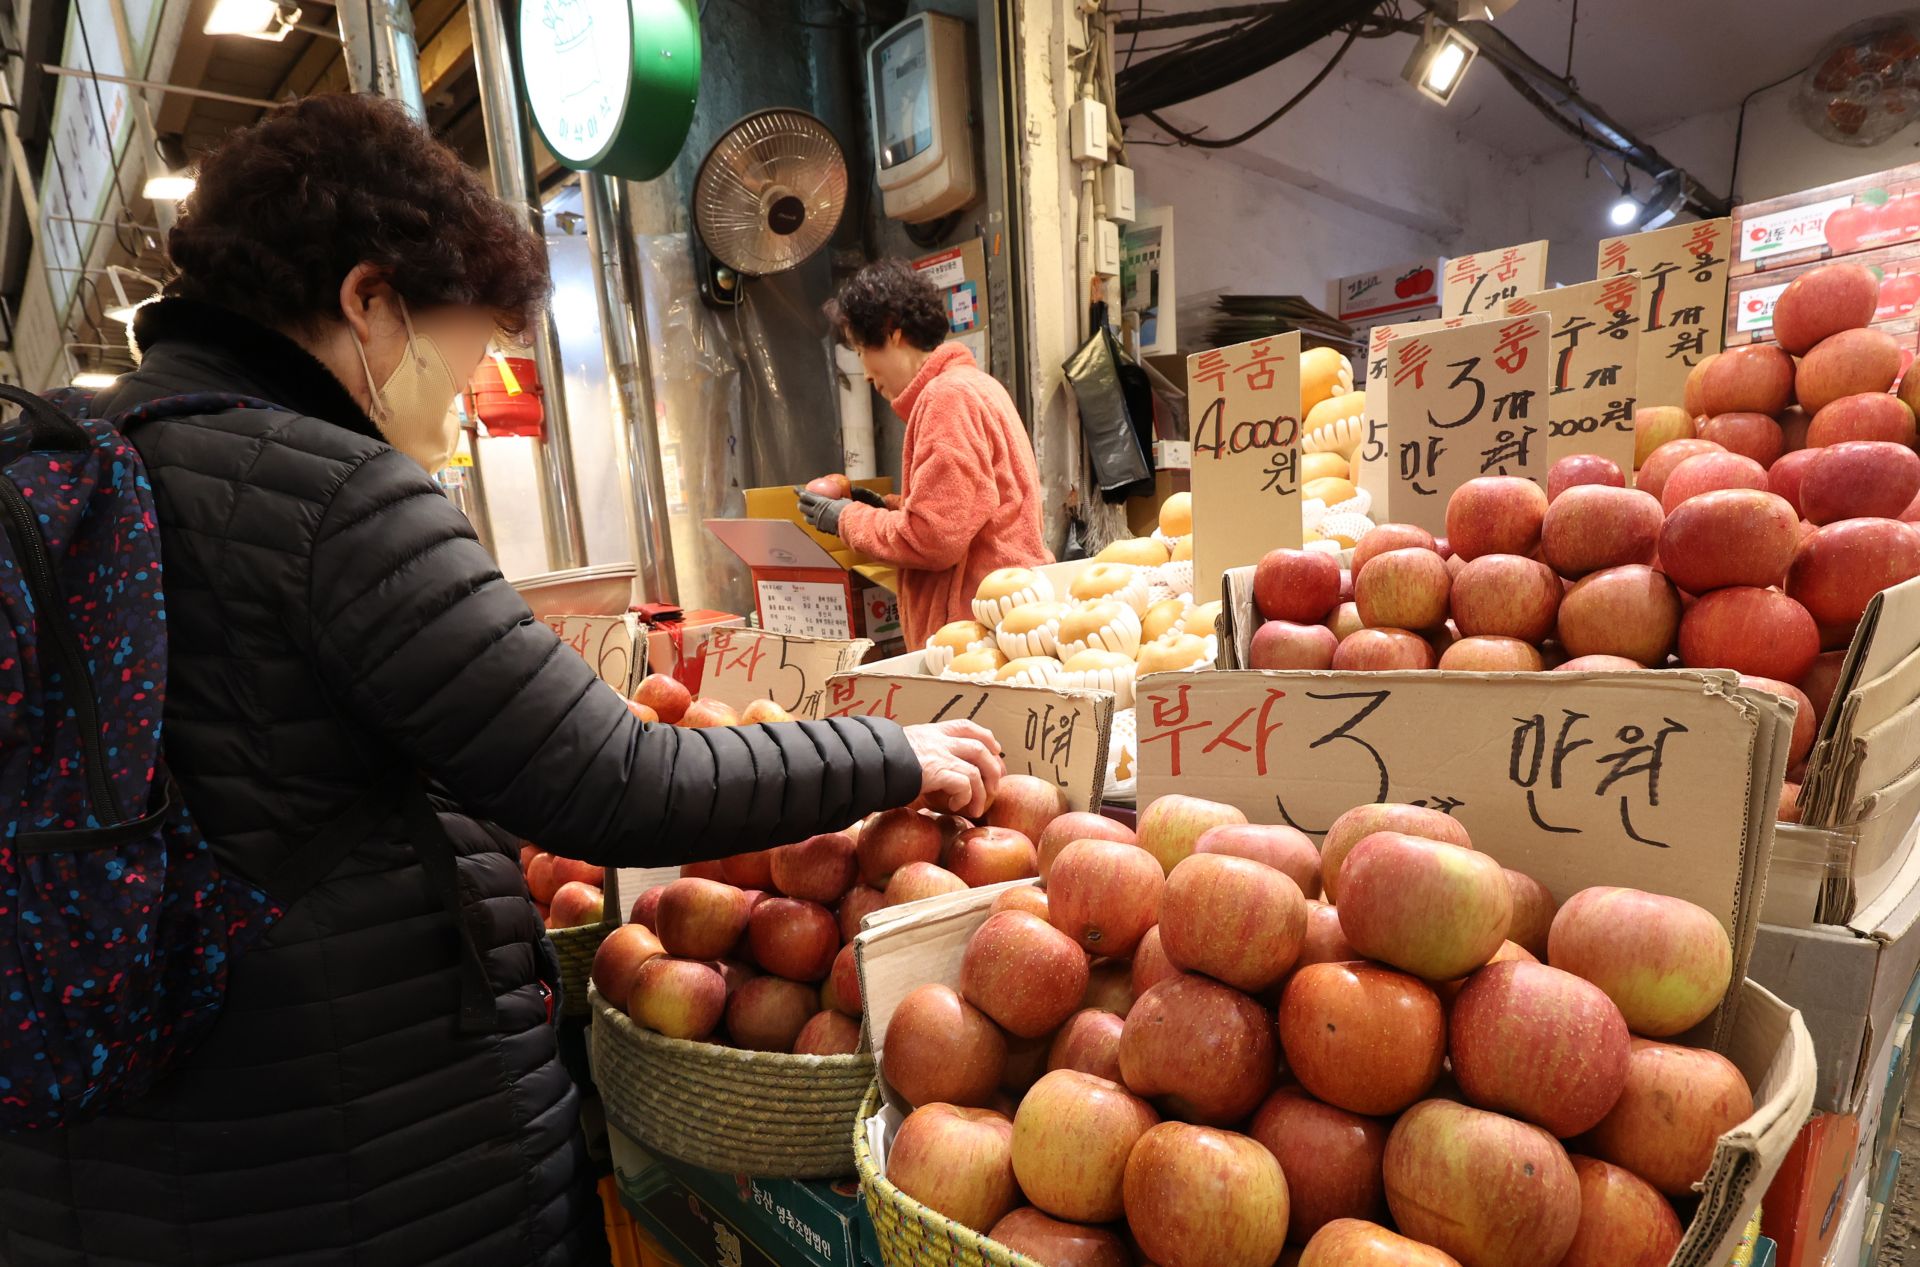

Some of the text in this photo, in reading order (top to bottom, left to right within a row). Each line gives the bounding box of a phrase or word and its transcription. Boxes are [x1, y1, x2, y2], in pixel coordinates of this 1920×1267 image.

[1789, 217, 1824, 236] 사과
[1613, 253, 1726, 289] 수용
[1669, 306, 1706, 327] 개
[1666, 328, 1709, 366] 원
[1426, 357, 1536, 429] 3 개
[1583, 364, 1623, 389] 개
[1260, 448, 1297, 496] 원
[598, 620, 628, 691] 6
[706, 629, 766, 682] 부사
[769, 635, 806, 713] 5
[802, 689, 825, 721] 개
[1140, 684, 1689, 849] 부사 3 만원
[776, 1204, 833, 1262] 영농조합법인
